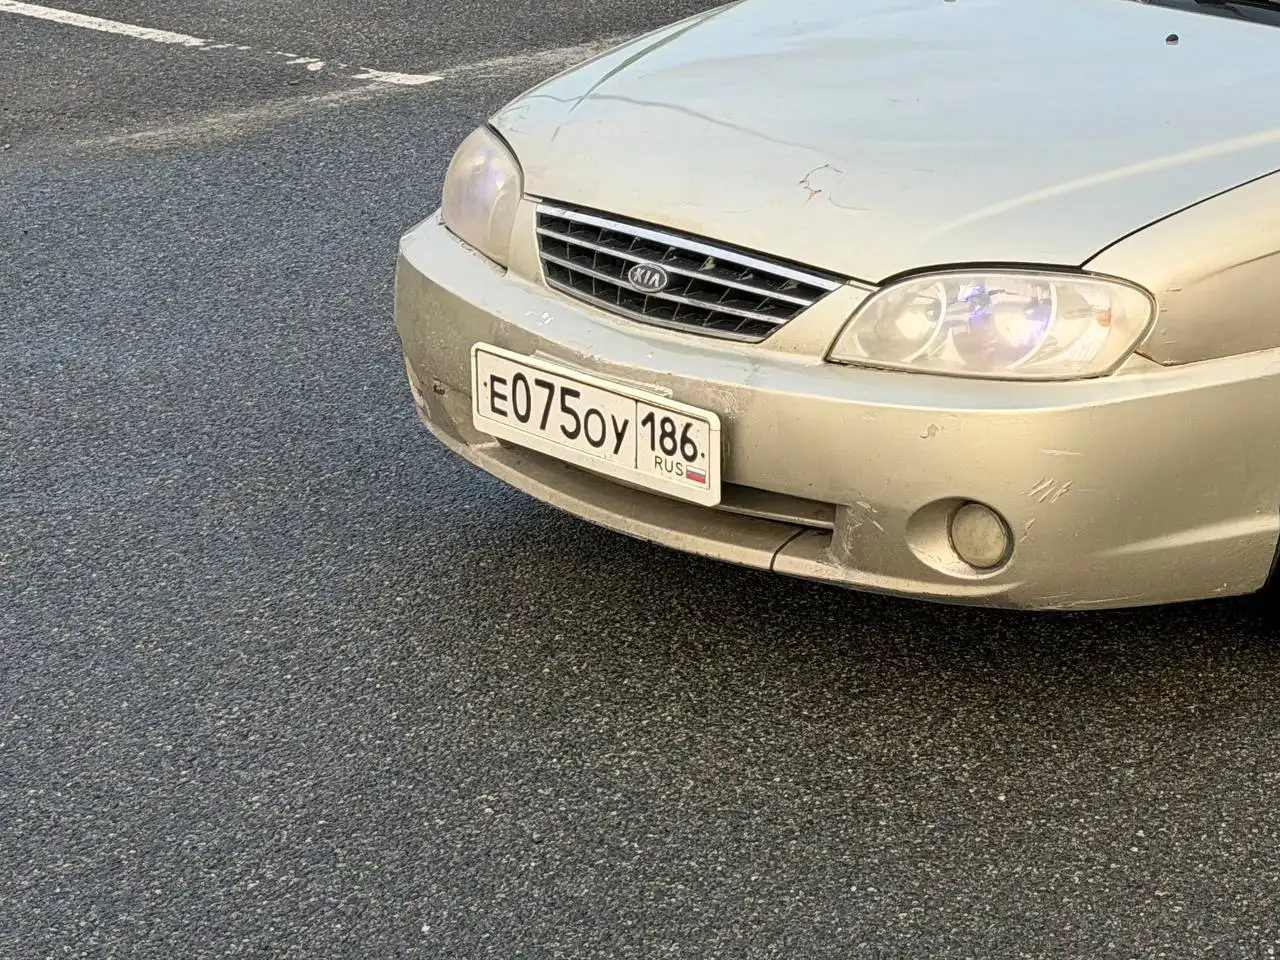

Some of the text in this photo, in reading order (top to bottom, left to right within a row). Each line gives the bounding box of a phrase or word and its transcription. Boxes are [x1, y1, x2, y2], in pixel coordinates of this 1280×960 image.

[632, 267, 660, 288] KIA
[641, 410, 698, 463] 186
[654, 455, 684, 477] RUS
